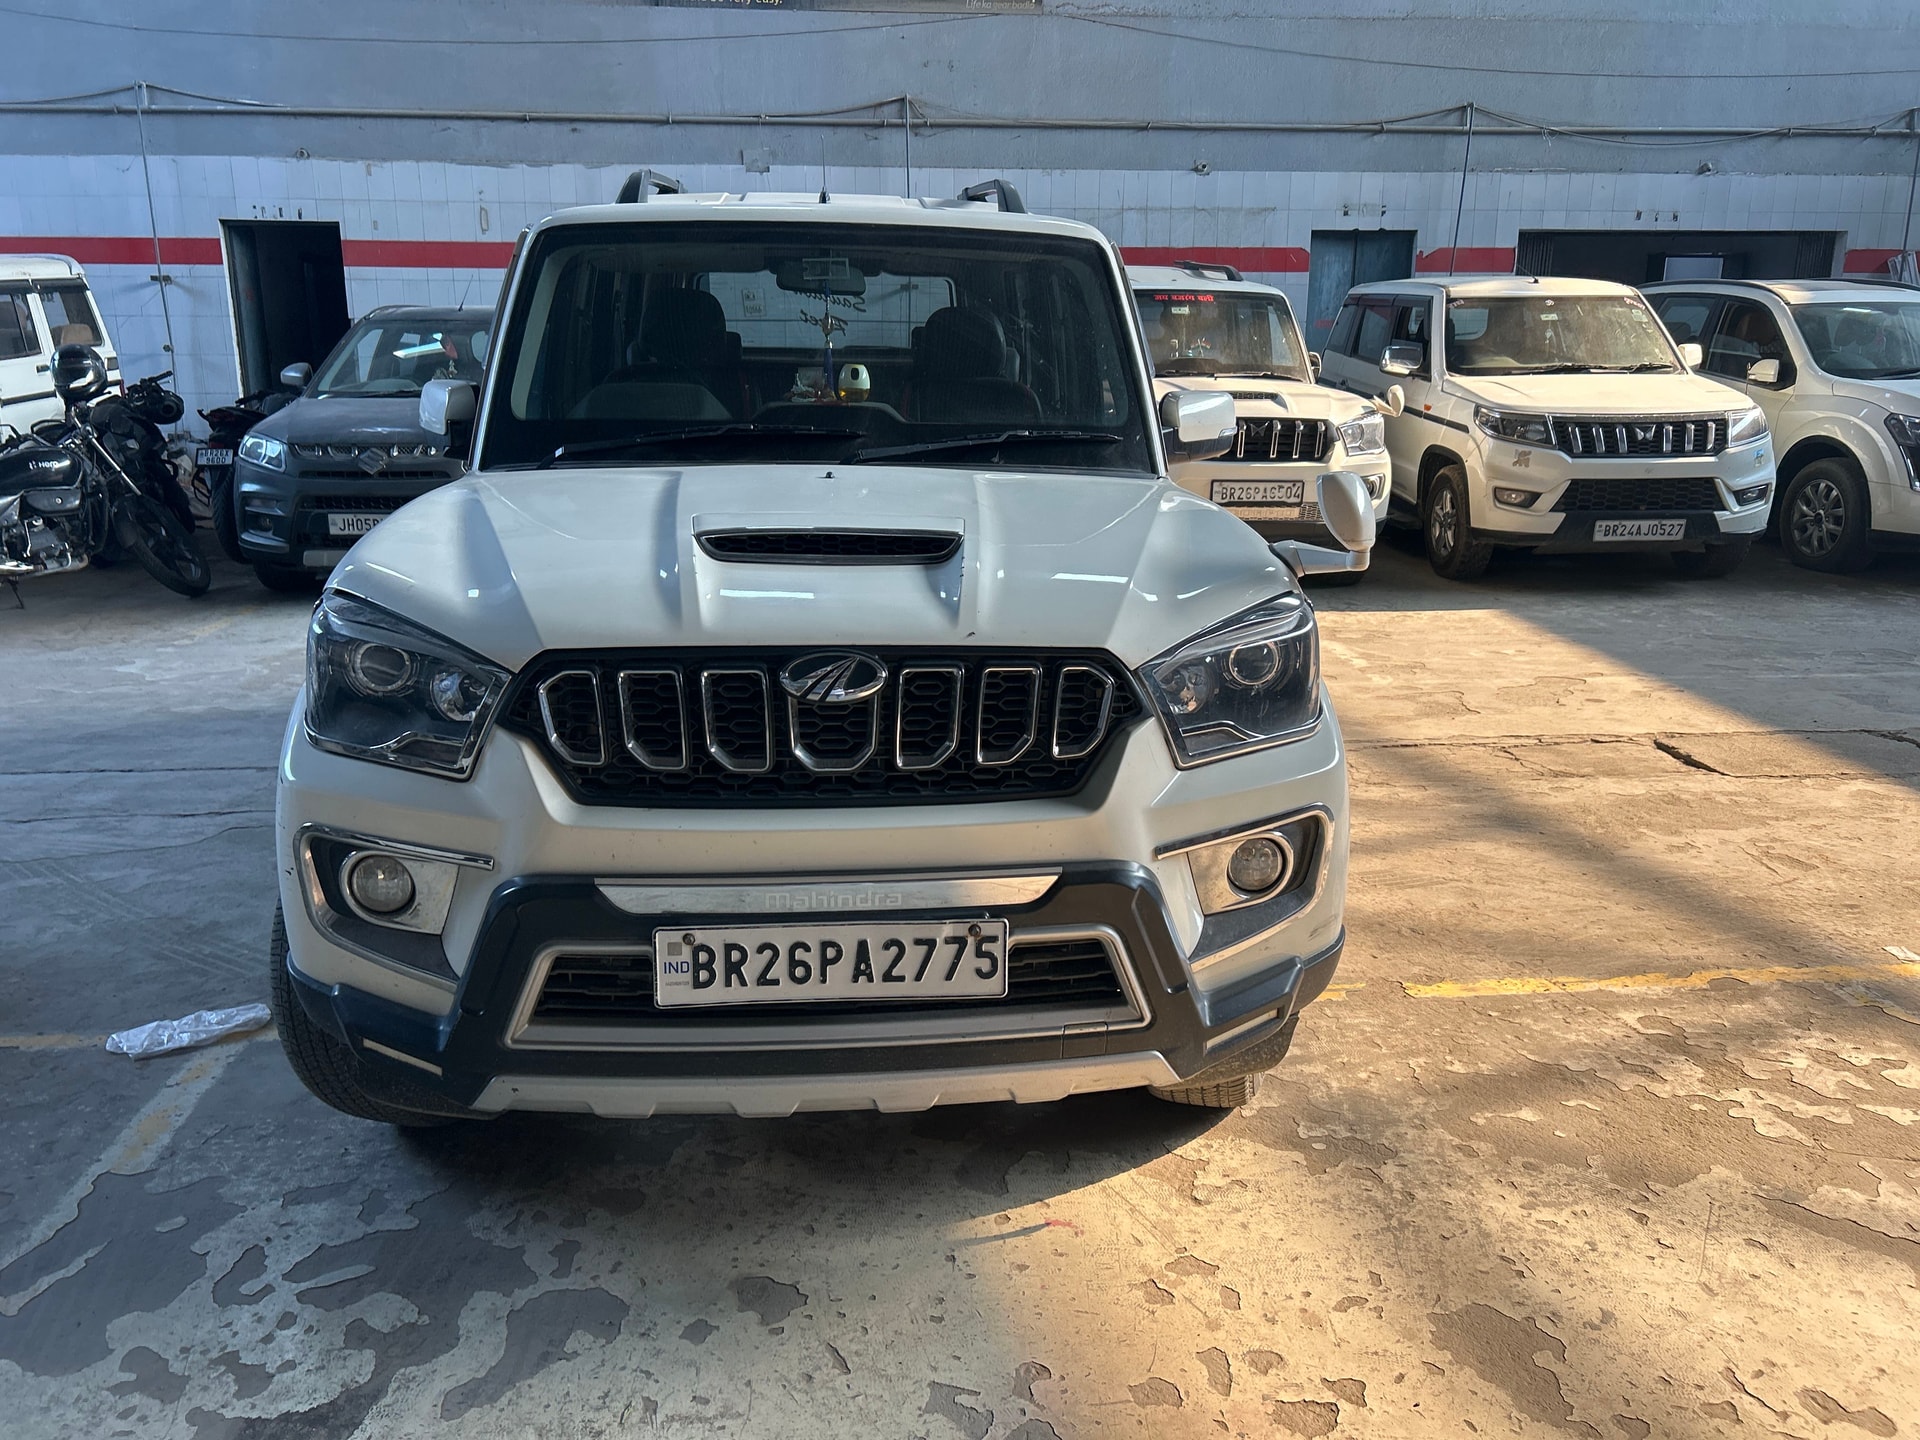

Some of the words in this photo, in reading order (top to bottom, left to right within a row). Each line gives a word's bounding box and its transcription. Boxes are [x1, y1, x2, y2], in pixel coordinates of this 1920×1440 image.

[1603, 523, 1684, 537] BR24AJ0527
[664, 961, 690, 974] IND
[692, 935, 999, 990] BR26PA2775
